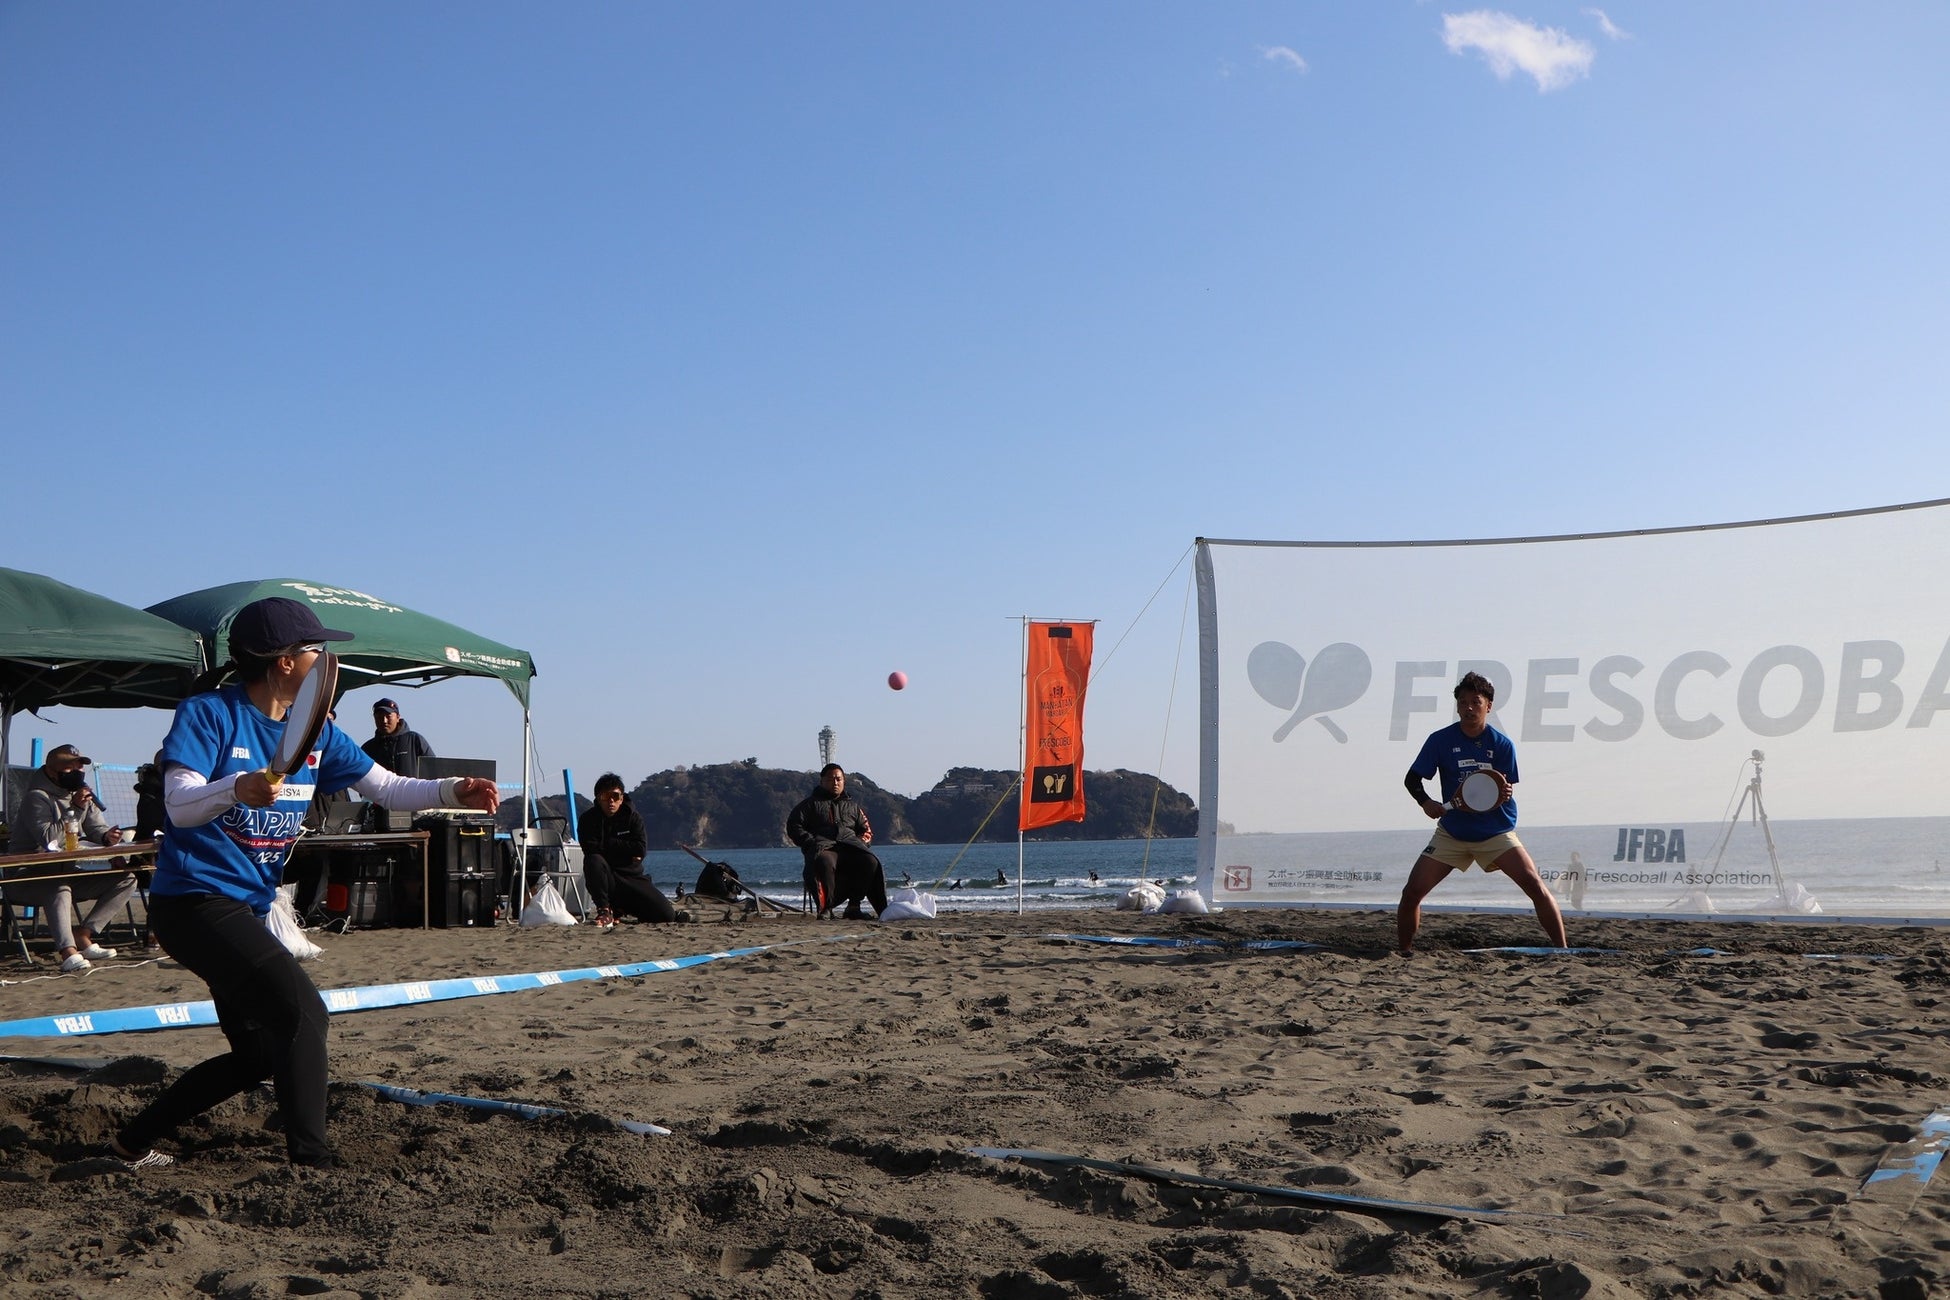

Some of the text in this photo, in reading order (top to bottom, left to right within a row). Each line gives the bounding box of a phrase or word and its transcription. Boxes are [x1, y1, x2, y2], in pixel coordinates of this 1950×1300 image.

[232, 747, 250, 759] JFBA
[1613, 827, 1686, 864] JFBA
[1585, 867, 1667, 885] Frescoball
[1672, 871, 1772, 886] Association
[329, 990, 359, 1008] JFBA
[404, 983, 432, 1000] JFBA
[53, 1014, 94, 1034] JFBA
[154, 1006, 191, 1024] JFBA
